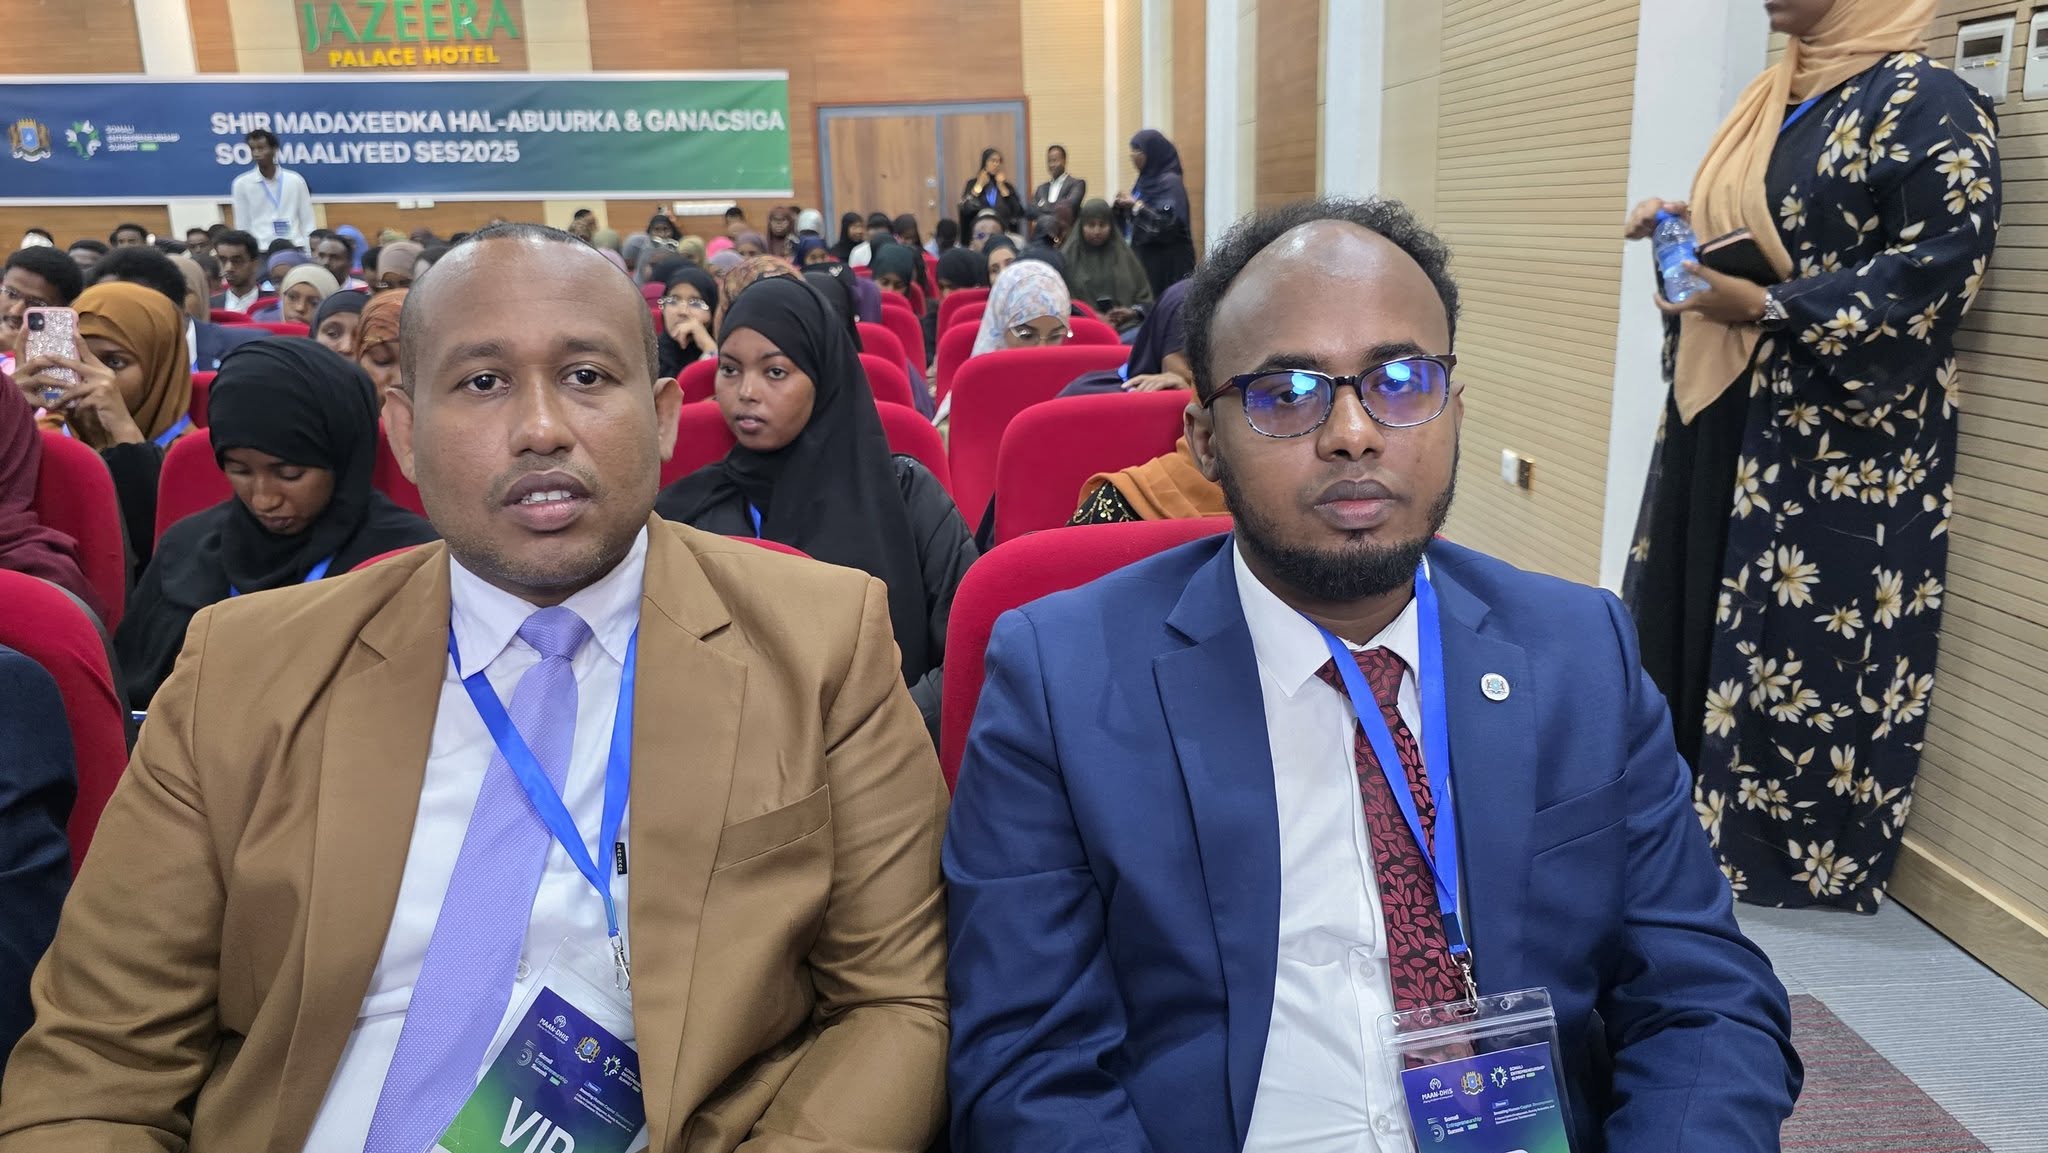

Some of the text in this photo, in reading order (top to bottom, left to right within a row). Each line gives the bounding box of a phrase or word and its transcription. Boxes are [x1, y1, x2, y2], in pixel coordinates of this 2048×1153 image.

[302, 0, 520, 53] JAZEERA
[328, 45, 499, 68] PALACE HOTEL
[210, 109, 786, 135] SHIR MADAXEEDKA HAL-ABUURKA & GANACSIGA
[215, 140, 520, 165] SOMAALIYEED SES2025
[539, 1017, 569, 1042] MAAN-DHIS
[1421, 1088, 1453, 1100] MAAN-DHIS
[500, 1096, 575, 1153] VIP
